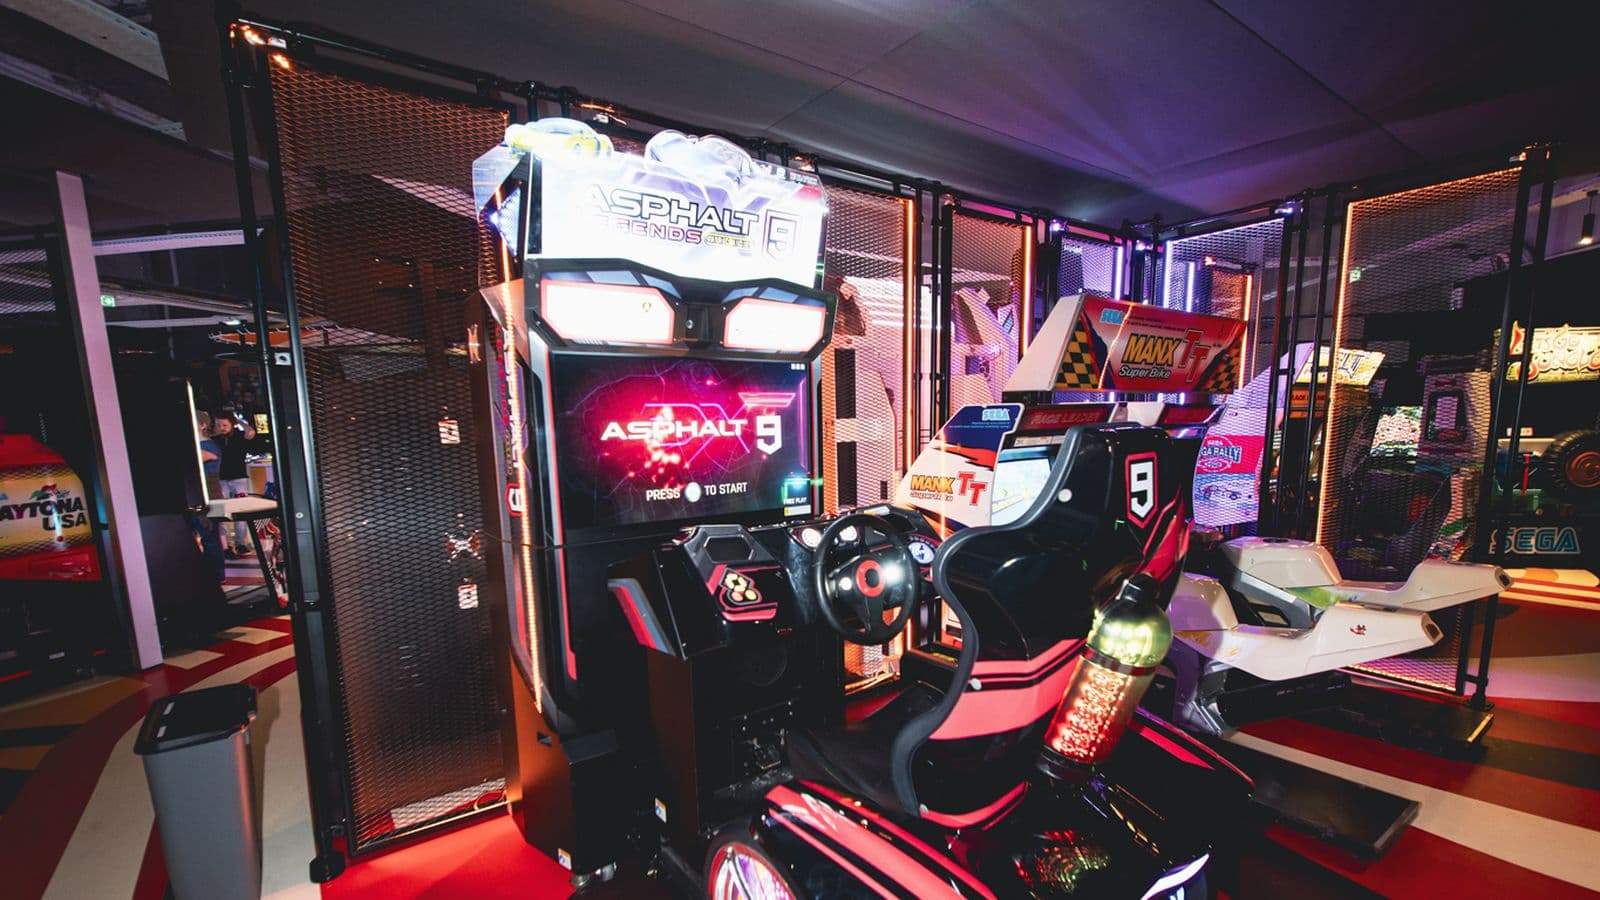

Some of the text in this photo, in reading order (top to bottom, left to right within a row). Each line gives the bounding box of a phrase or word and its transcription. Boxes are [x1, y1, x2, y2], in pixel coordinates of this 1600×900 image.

[590, 184, 760, 237] ASPHALT
[1121, 328, 1212, 383] MANX TT
[600, 415, 783, 455] ASPHALT 9
[646, 482, 748, 501] PRESS TO START
[909, 470, 988, 507] MANX TT
[1130, 461, 1153, 519] 9
[0, 497, 84, 521] AYTONA
[43, 512, 87, 531] USA
[1488, 527, 1581, 555] SEGA
